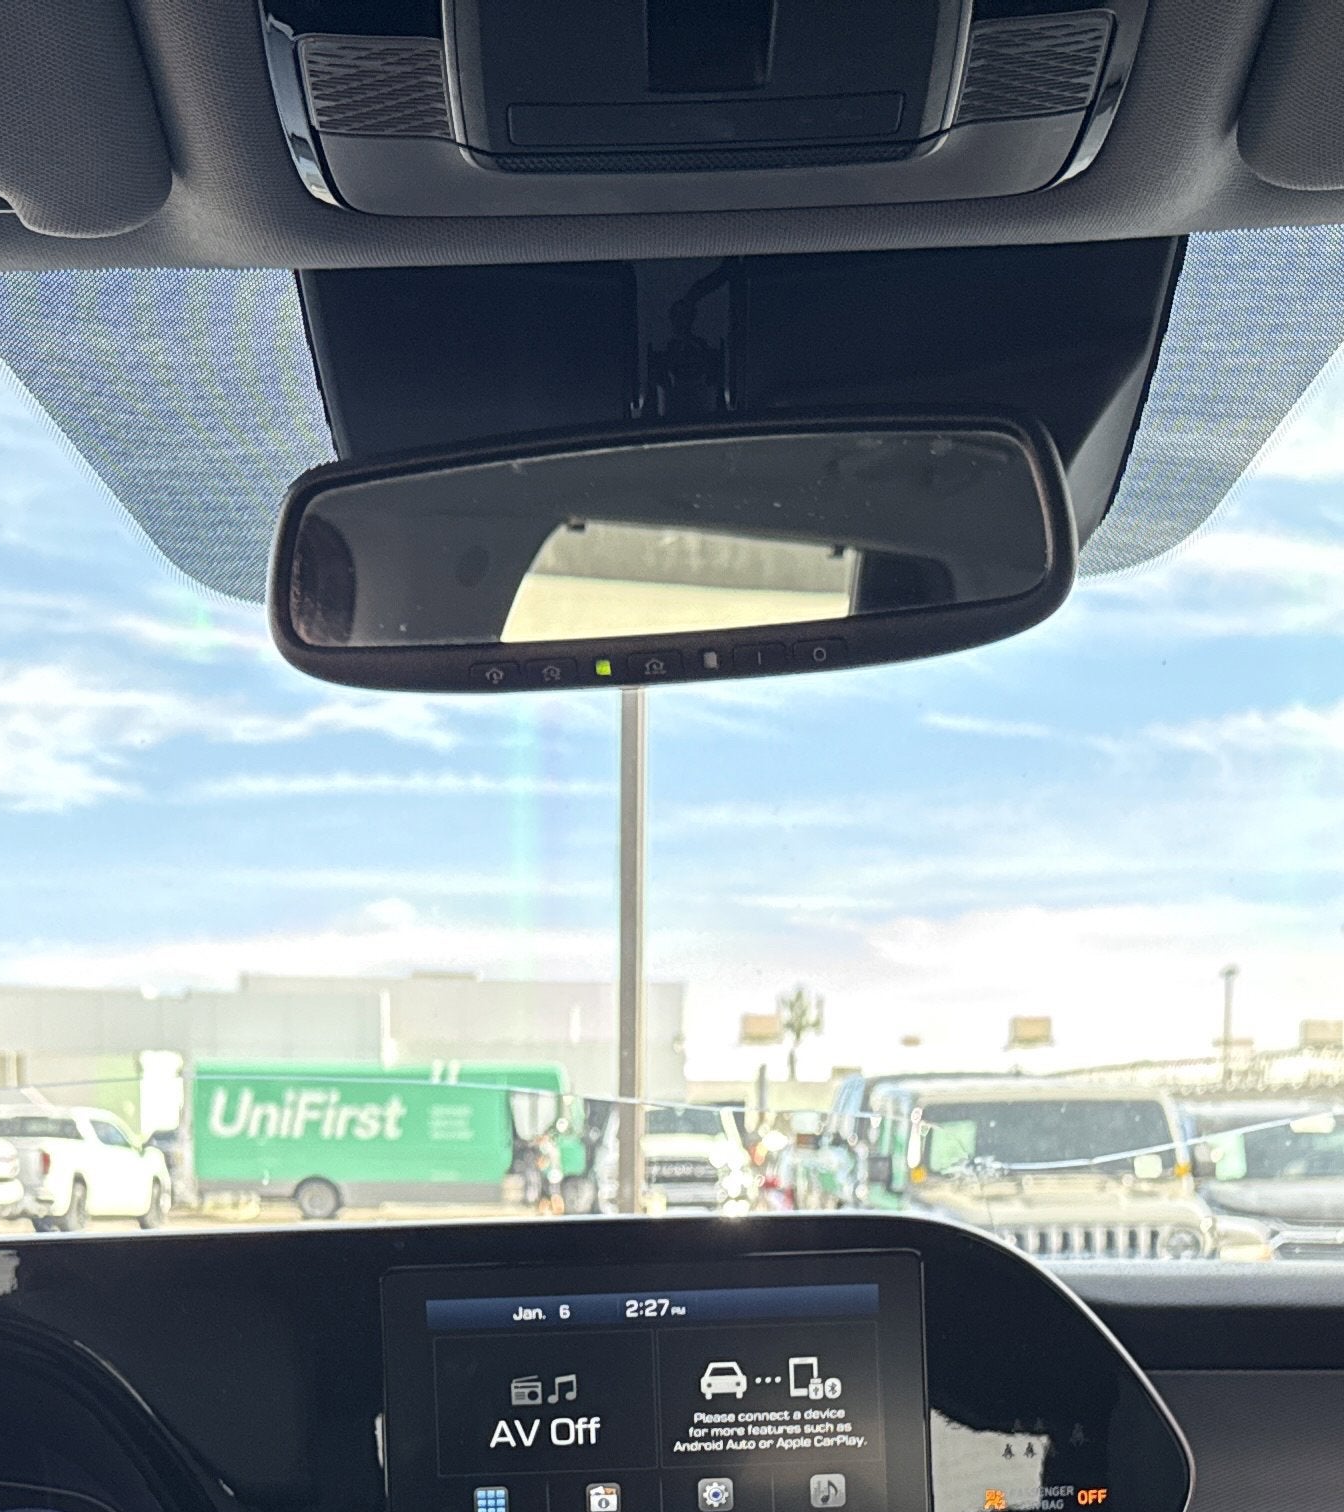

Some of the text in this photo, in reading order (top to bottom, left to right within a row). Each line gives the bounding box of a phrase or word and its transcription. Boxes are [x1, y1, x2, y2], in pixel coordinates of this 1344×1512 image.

[209, 1087, 408, 1140] UniFirst
[513, 1306, 546, 1321] Jan.
[558, 1304, 571, 1319] 6
[626, 1299, 670, 1318] 2:27
[693, 1408, 846, 1424] Please connect a device
[490, 1416, 601, 1448] AV Off
[688, 1421, 852, 1438] for more features such as
[673, 1433, 868, 1452] Android Auto or Apple CarPlay.
[1077, 1489, 1107, 1506] OFF
